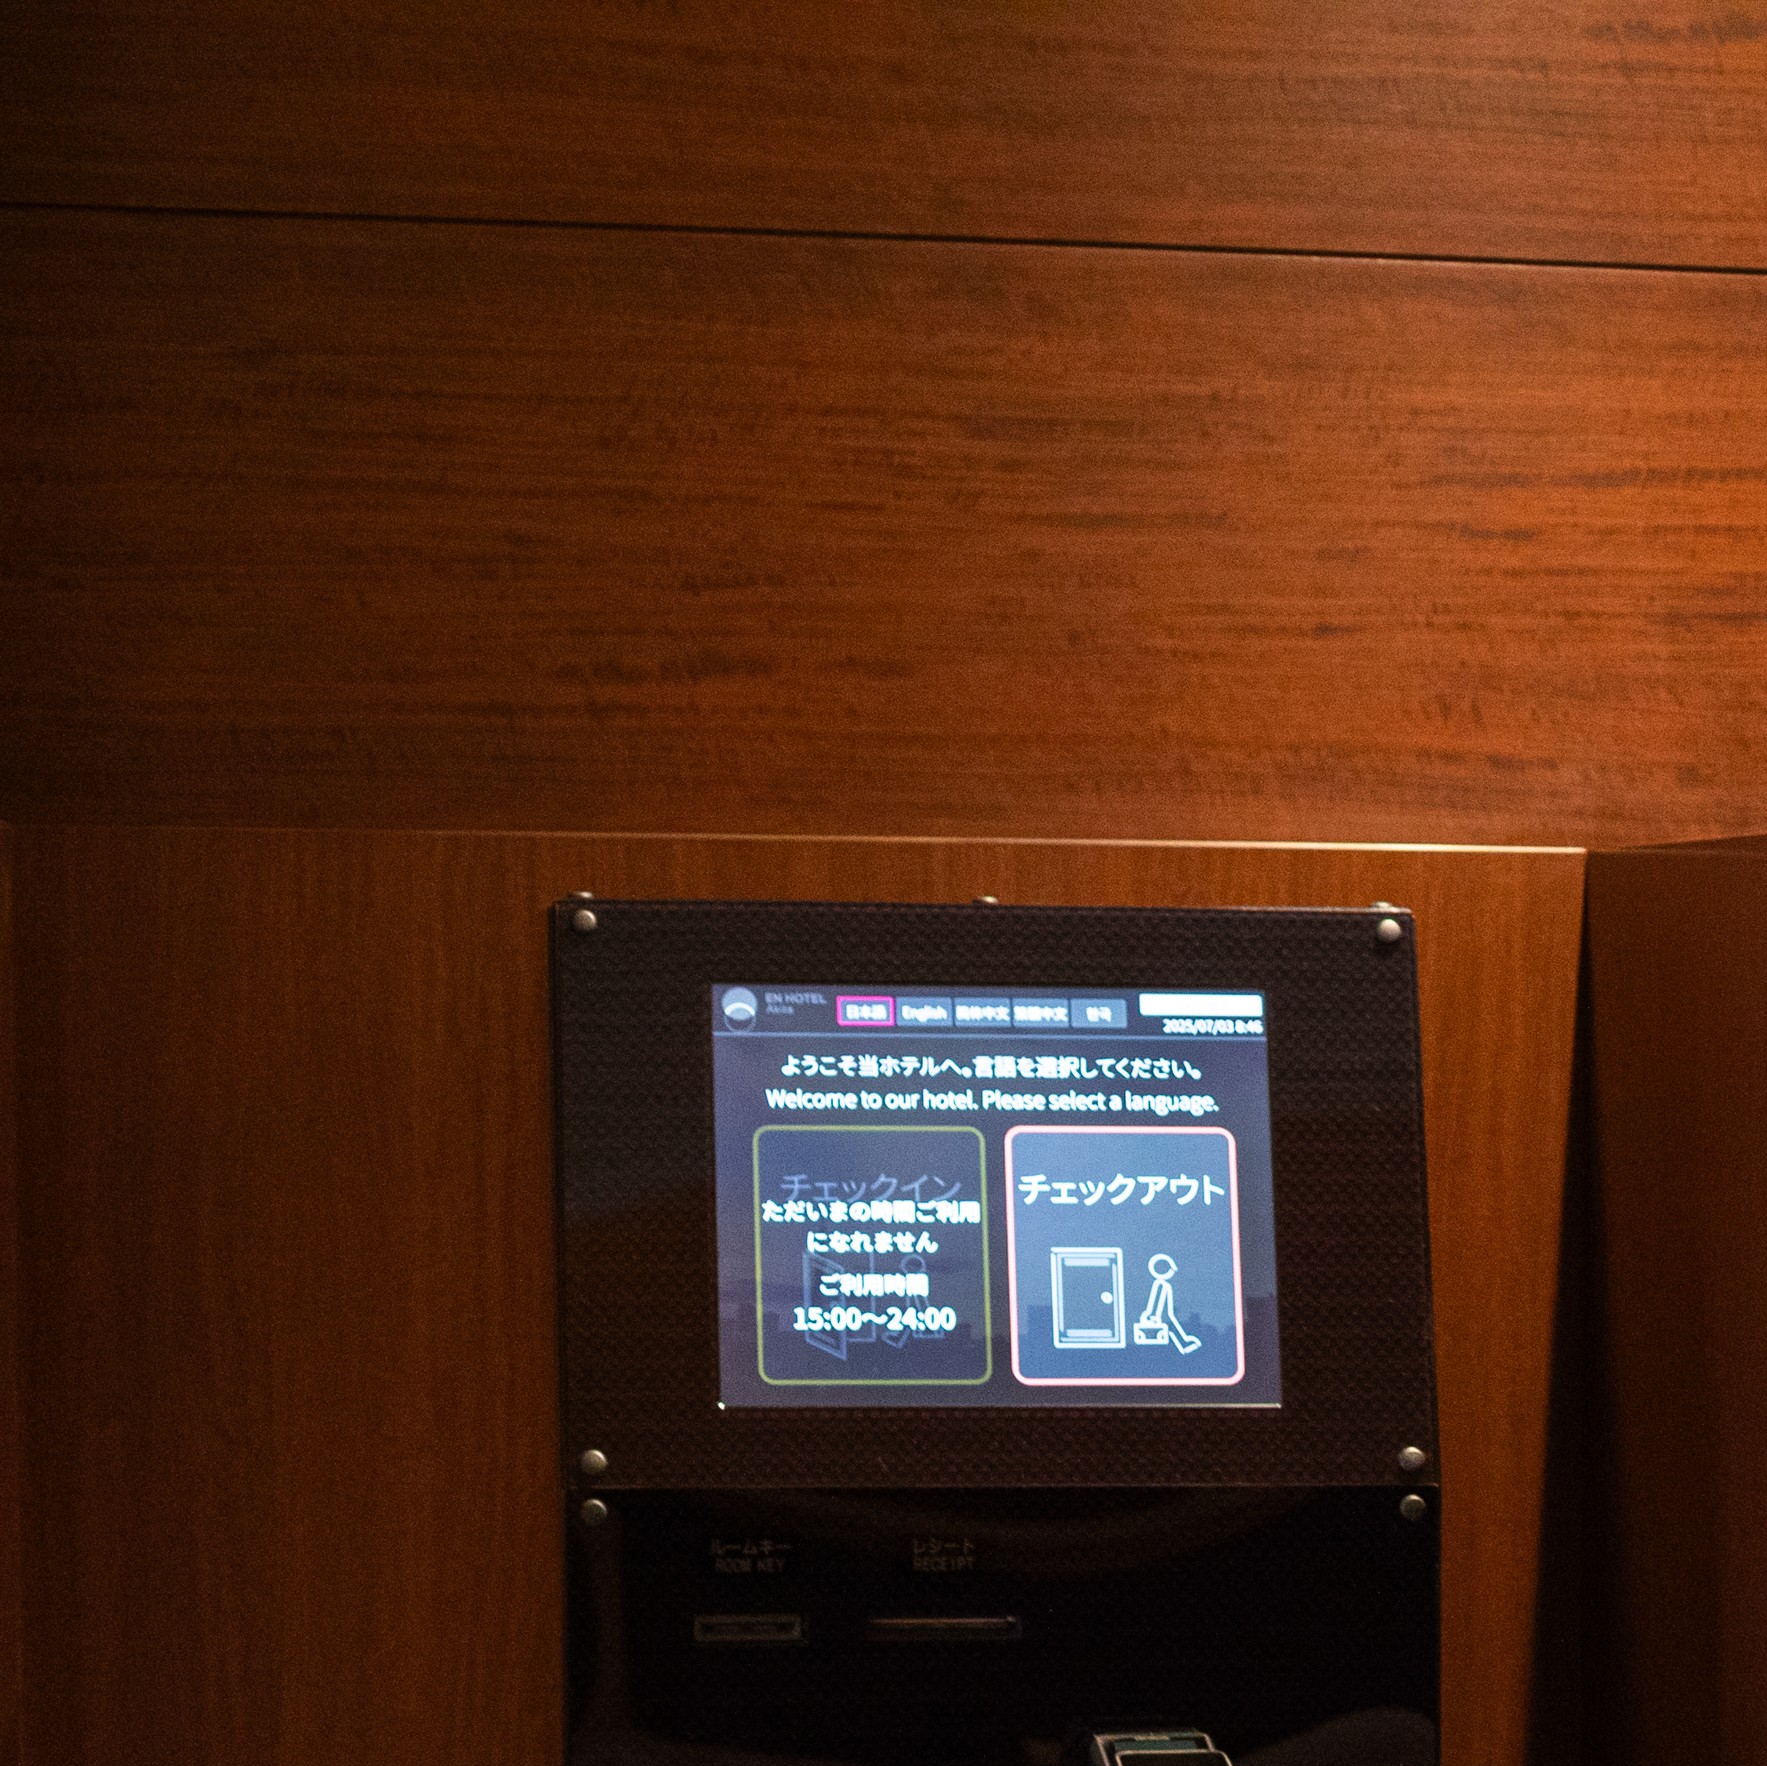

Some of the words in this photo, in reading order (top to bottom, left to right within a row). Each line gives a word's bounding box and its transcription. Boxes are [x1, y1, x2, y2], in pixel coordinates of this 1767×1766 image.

[785, 993, 827, 1005] HOTEL
[845, 1003, 887, 1021] 日本語
[902, 1005, 948, 1022] English
[780, 1054, 1202, 1080] ようこそ当ホテルへ。言語を選択してください。
[765, 1089, 860, 1110] Welcome
[860, 1090, 883, 1110] to
[884, 1093, 921, 1110] our
[923, 1089, 979, 1110] hotel.
[982, 1090, 1047, 1111] Please
[1049, 1090, 1107, 1111] select
[1108, 1094, 1123, 1111] a
[1125, 1090, 1220, 1116] language.
[779, 1173, 962, 1202] チェックイン
[1018, 1173, 1225, 1206] チェックアウト
[762, 1199, 981, 1224] ただいまの時間ご利用
[806, 1230, 939, 1254] になれません
[819, 1273, 929, 1297] ご利用時間
[710, 1538, 793, 1555] ルームキー
[913, 1537, 975, 1554] レシート
[715, 1558, 751, 1573] ROOM
[756, 1558, 785, 1573] KEY
[913, 1556, 975, 1572] RECEIPT
